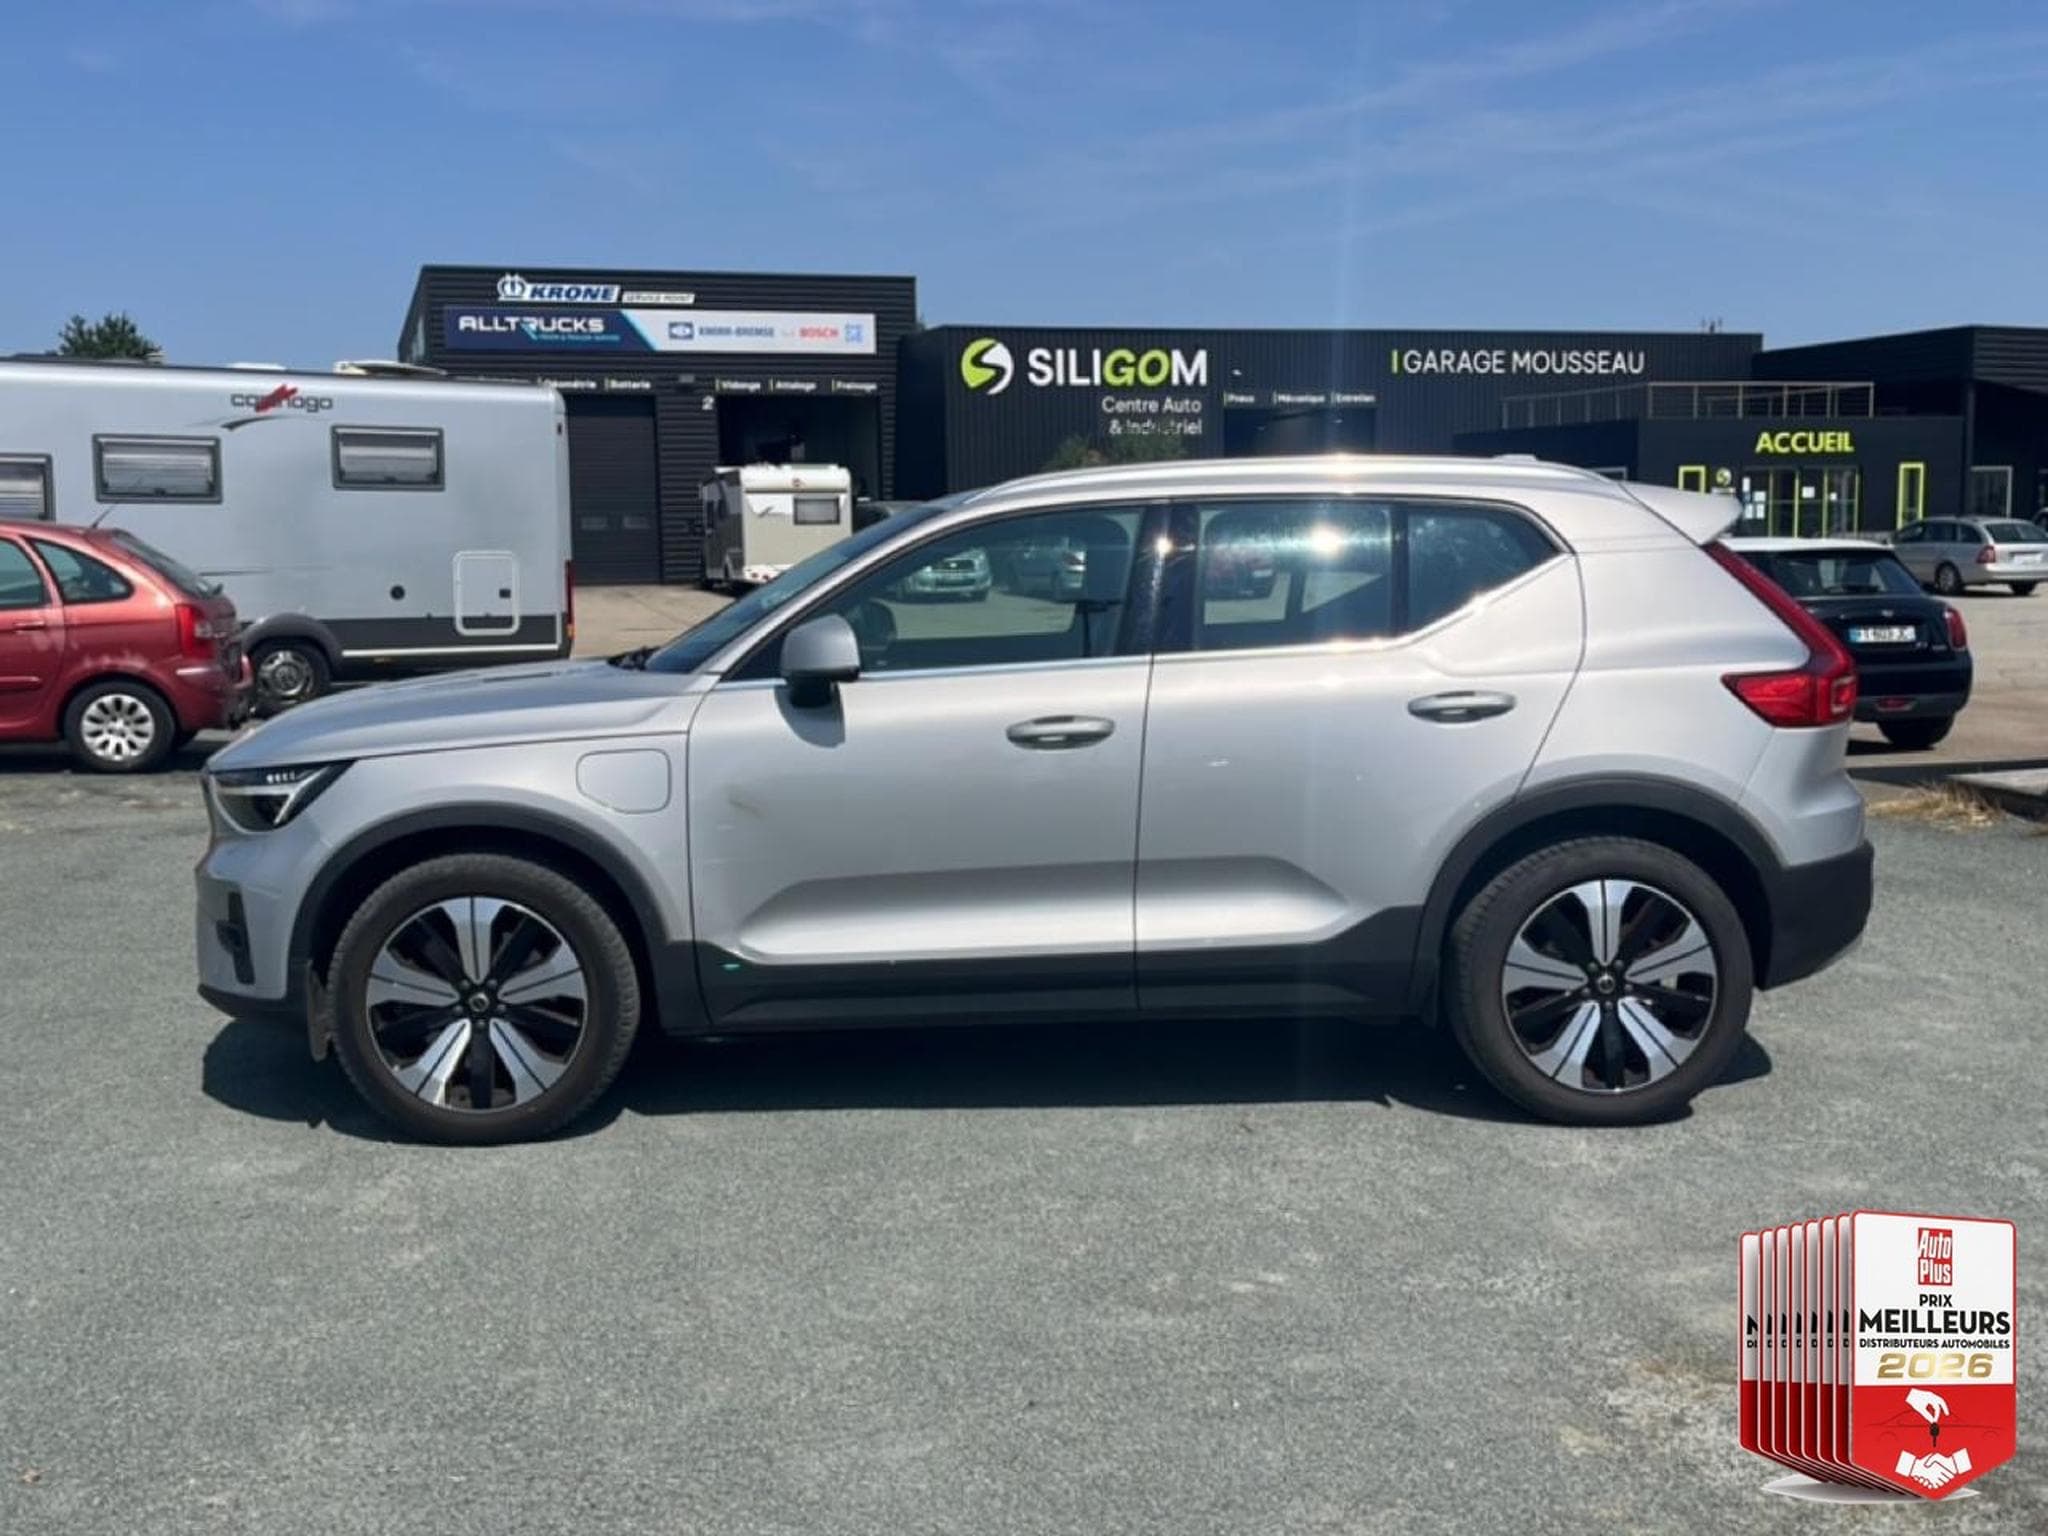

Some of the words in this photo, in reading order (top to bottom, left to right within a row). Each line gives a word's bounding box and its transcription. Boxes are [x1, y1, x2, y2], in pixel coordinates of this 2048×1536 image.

[530, 285, 616, 300] KRONE
[458, 315, 605, 334] ALLTRUCKS
[1027, 348, 1207, 386] SILIGOM
[1403, 350, 1506, 374] GARAGE
[1511, 351, 1645, 374] MOUSSEAU
[701, 395, 715, 411] 2
[1101, 396, 1159, 413] Centre
[1162, 397, 1203, 413] Auto
[1108, 419, 1123, 435] &
[1126, 419, 1203, 435] Indriel
[1755, 431, 1854, 453] ACCUEIL
